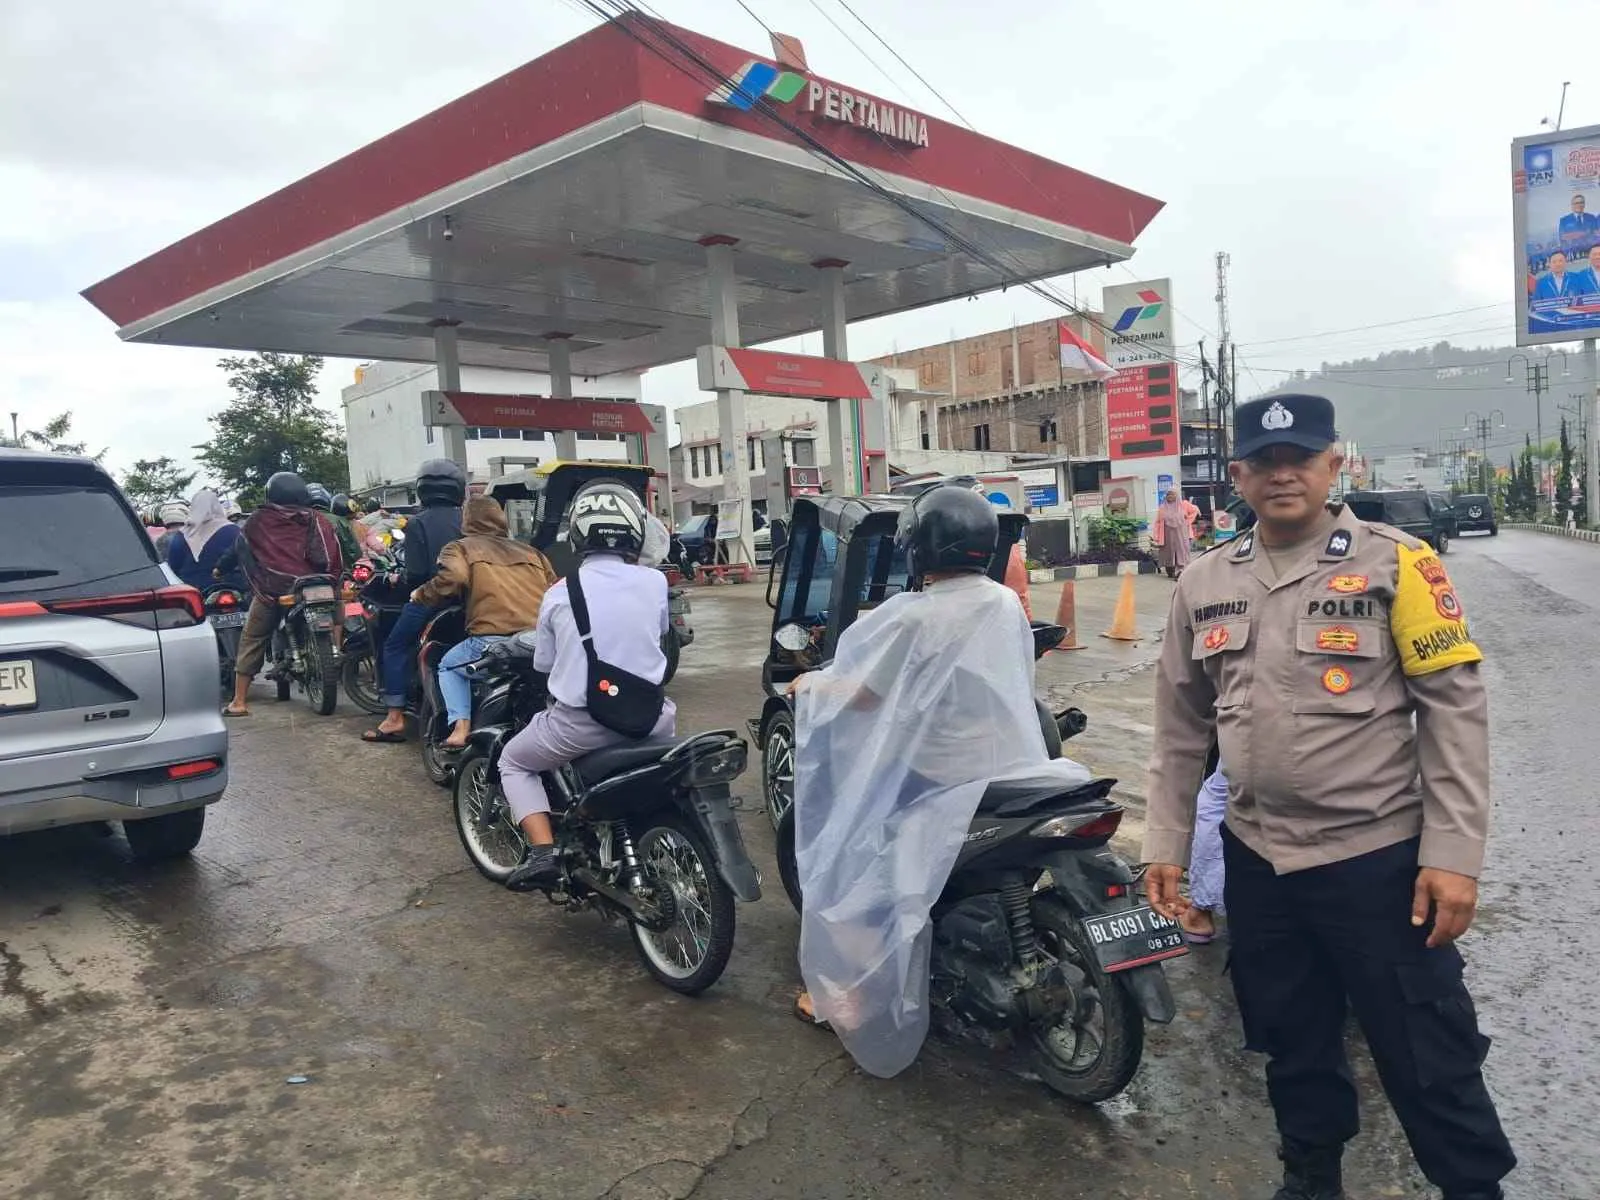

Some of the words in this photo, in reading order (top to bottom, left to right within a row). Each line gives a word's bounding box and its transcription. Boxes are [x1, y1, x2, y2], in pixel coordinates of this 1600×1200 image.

[808, 80, 929, 148] PERTAMINA
[1111, 330, 1165, 345] PERTAMINA
[438, 401, 446, 415] 2
[1307, 600, 1373, 617] POLRI
